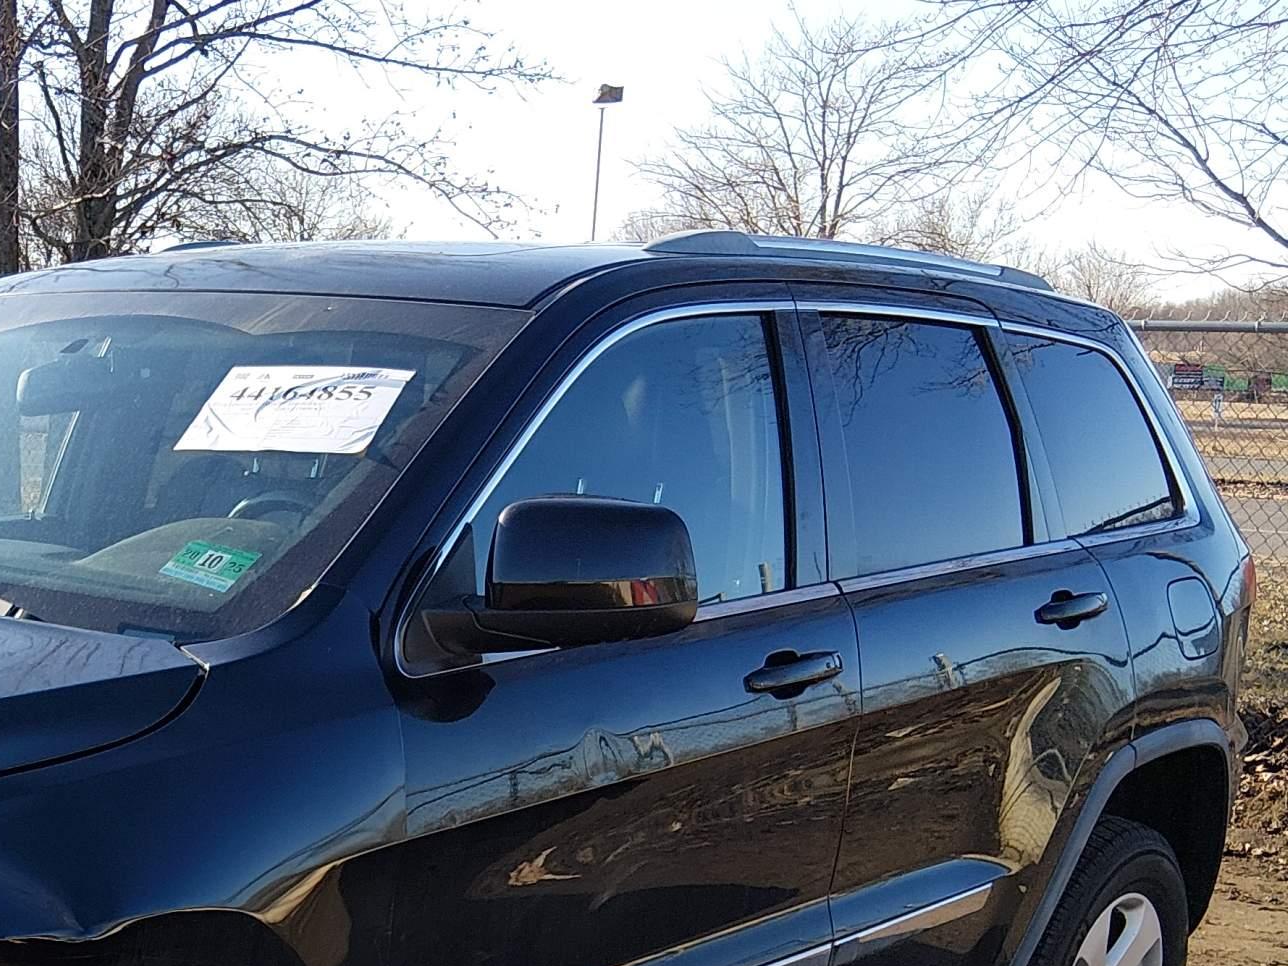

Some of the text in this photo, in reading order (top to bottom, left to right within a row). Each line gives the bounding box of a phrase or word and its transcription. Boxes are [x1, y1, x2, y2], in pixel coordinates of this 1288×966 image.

[229, 384, 377, 402] 44164855
[198, 553, 224, 570] 10
[224, 561, 247, 574] 25
